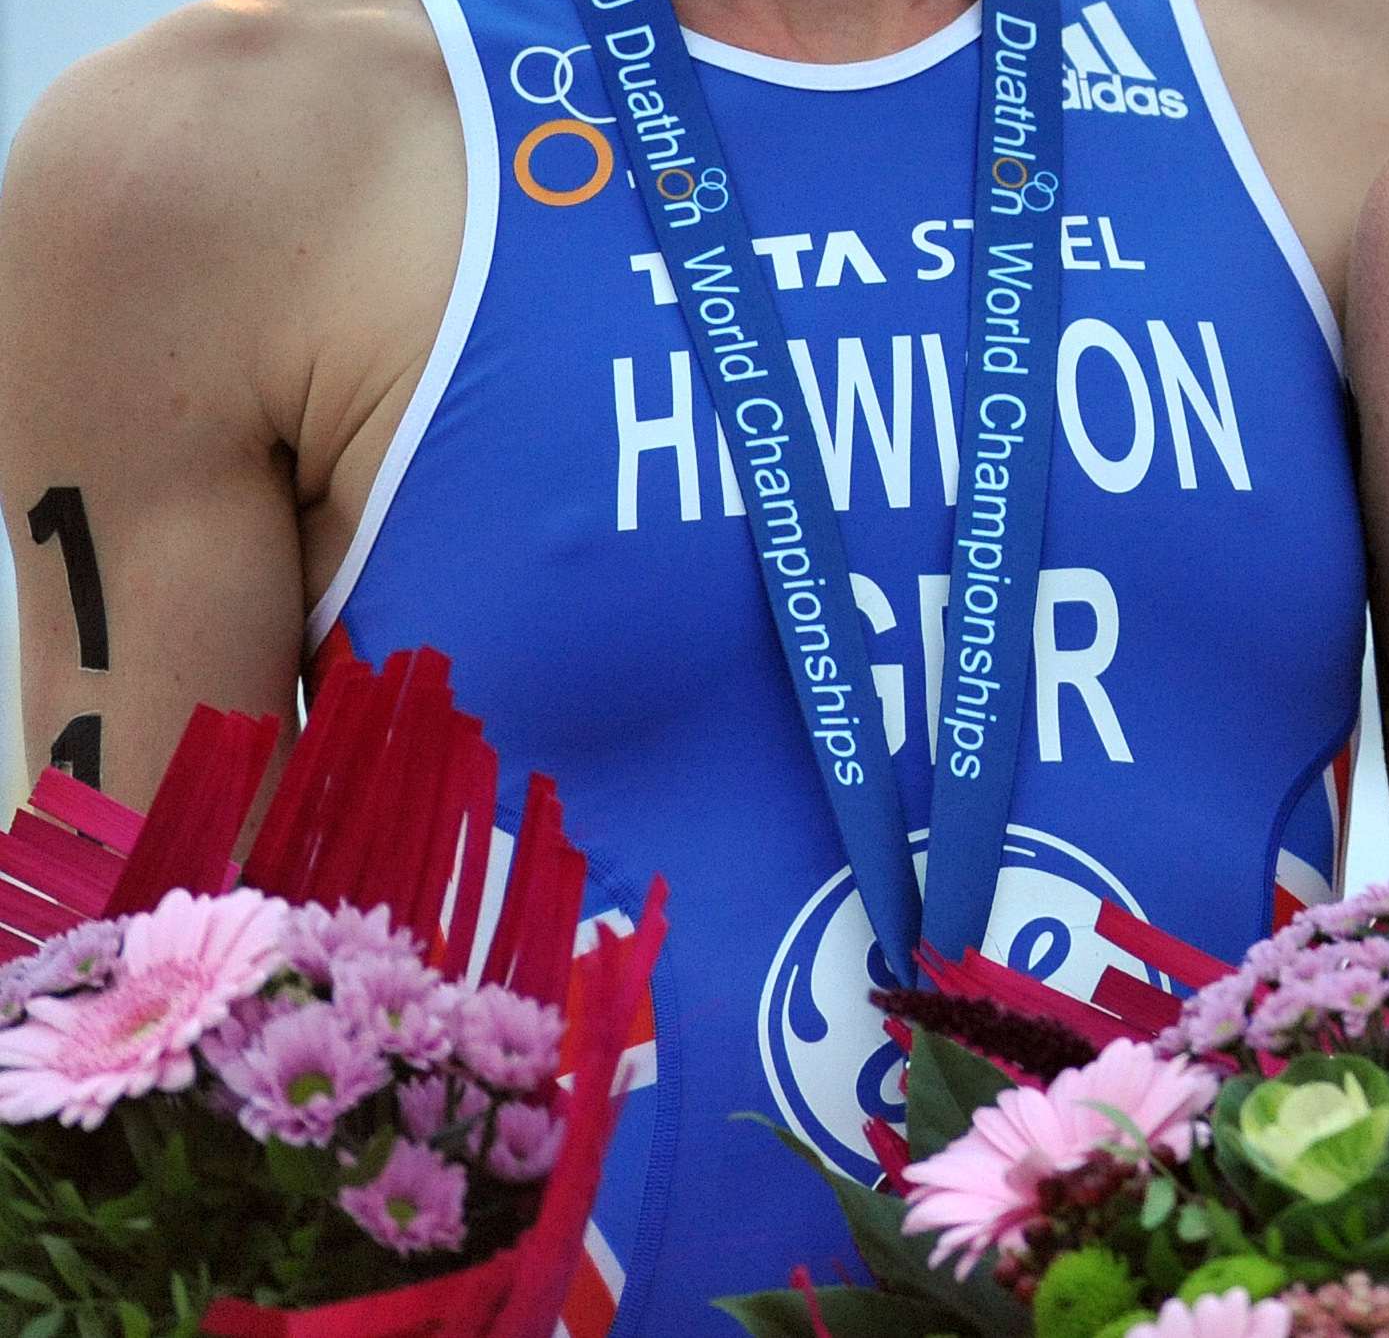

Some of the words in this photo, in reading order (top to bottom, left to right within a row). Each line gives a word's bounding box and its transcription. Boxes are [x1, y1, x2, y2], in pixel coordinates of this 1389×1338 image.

[989, 11, 1038, 216] Duathlon
[1061, 67, 1189, 119] didas
[631, 230, 887, 305] TTA
[915, 214, 1147, 283] SEL
[980, 240, 1034, 375] World
[604, 24, 702, 229] Duathlon
[683, 242, 767, 382] World
[734, 395, 866, 789] Championships
[611, 317, 1253, 532] HWION
[949, 391, 1029, 781] Championships
